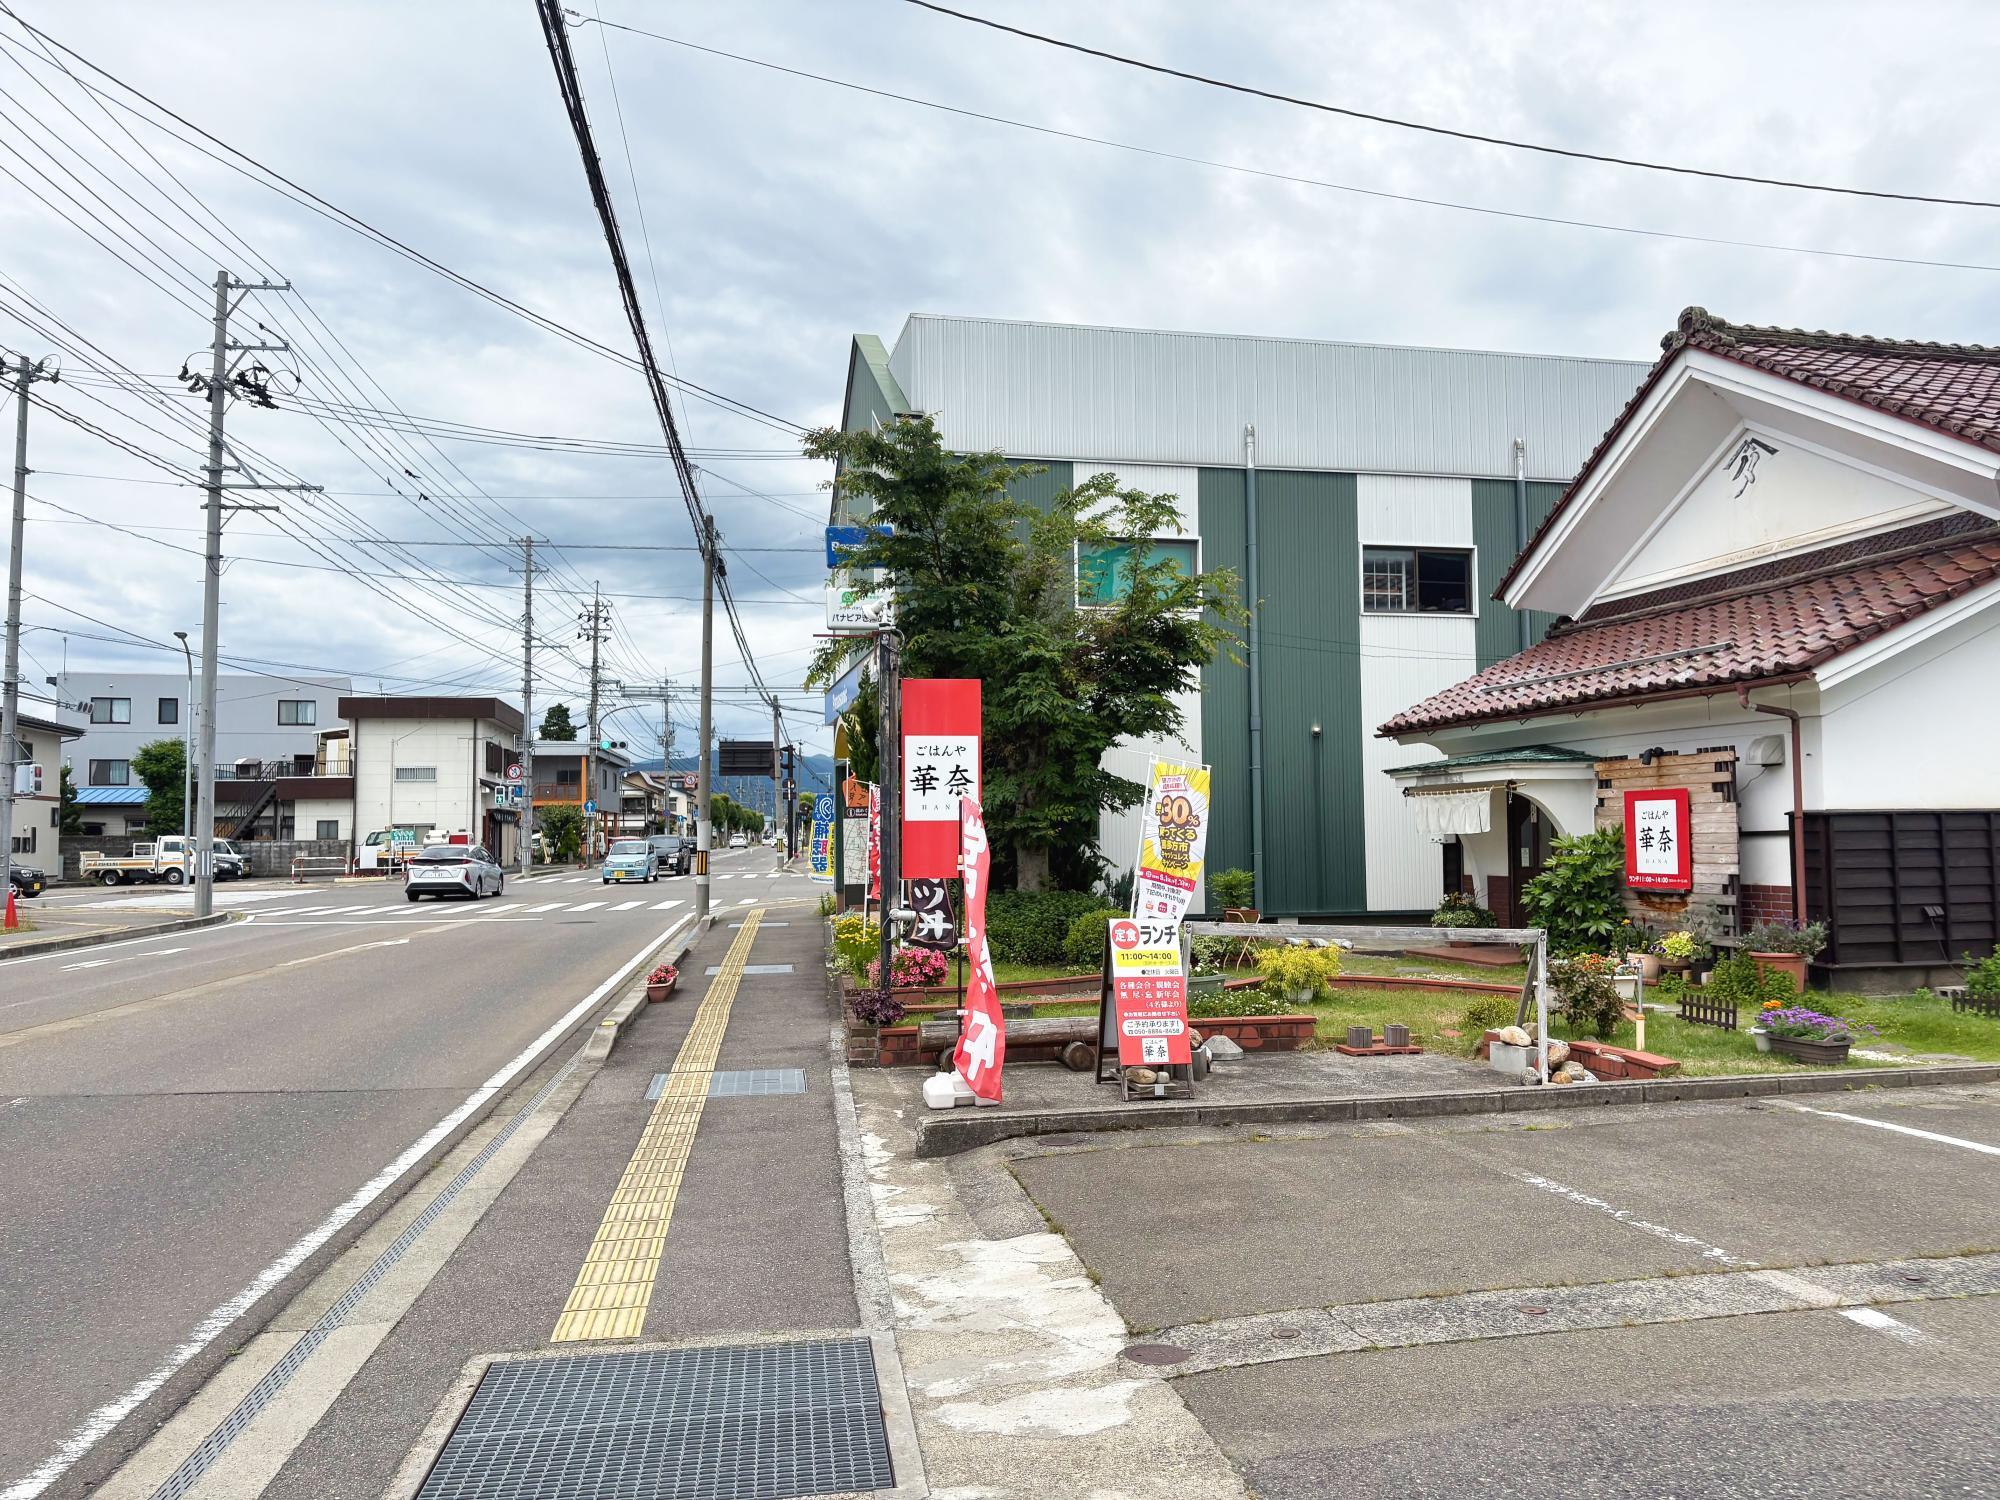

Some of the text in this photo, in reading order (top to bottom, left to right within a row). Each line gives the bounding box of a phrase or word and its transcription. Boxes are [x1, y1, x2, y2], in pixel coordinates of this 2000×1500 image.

[916, 745, 966, 757] ごはんや
[910, 764, 975, 797] 華奈
[1642, 810, 1669, 820] ごはんや
[1639, 826, 1674, 853] 華奈
[1114, 925, 1176, 944] 定食 ランチ
